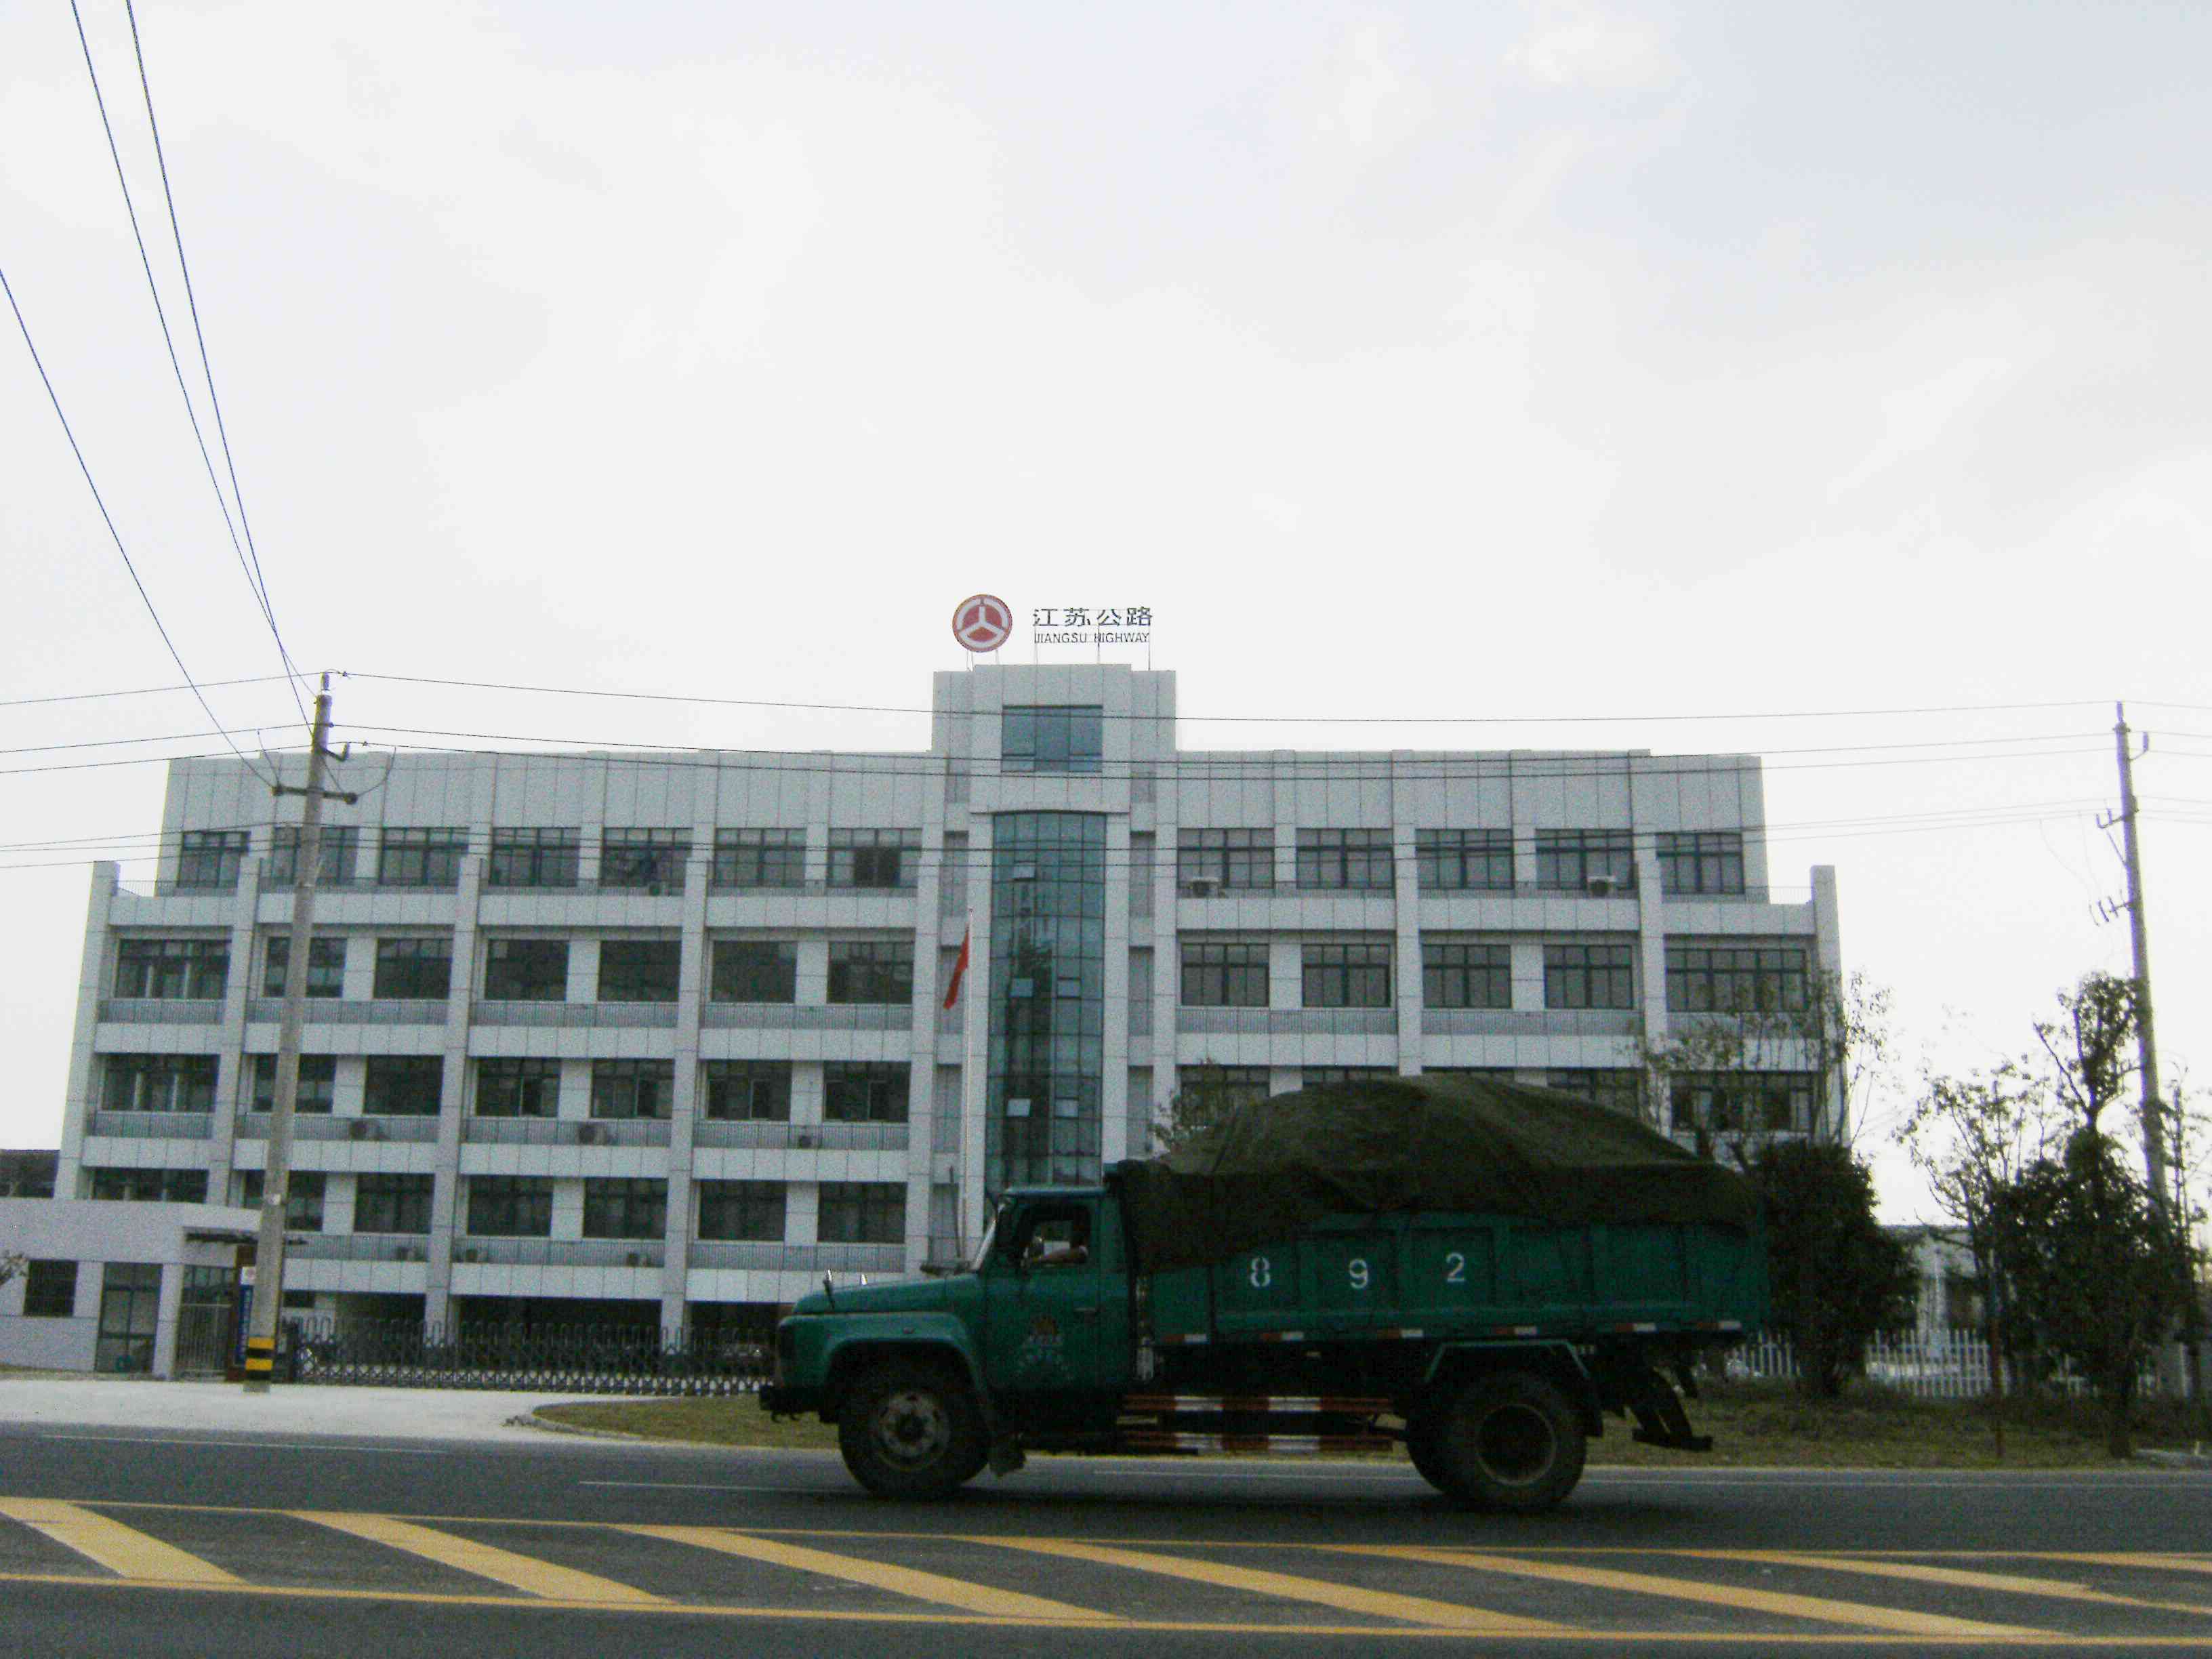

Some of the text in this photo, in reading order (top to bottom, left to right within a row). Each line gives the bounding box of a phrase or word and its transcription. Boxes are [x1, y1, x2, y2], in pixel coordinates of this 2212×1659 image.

[1033, 606, 1153, 627] 江苏公路
[1034, 632, 1150, 644] JIANGSU HIGHWAY
